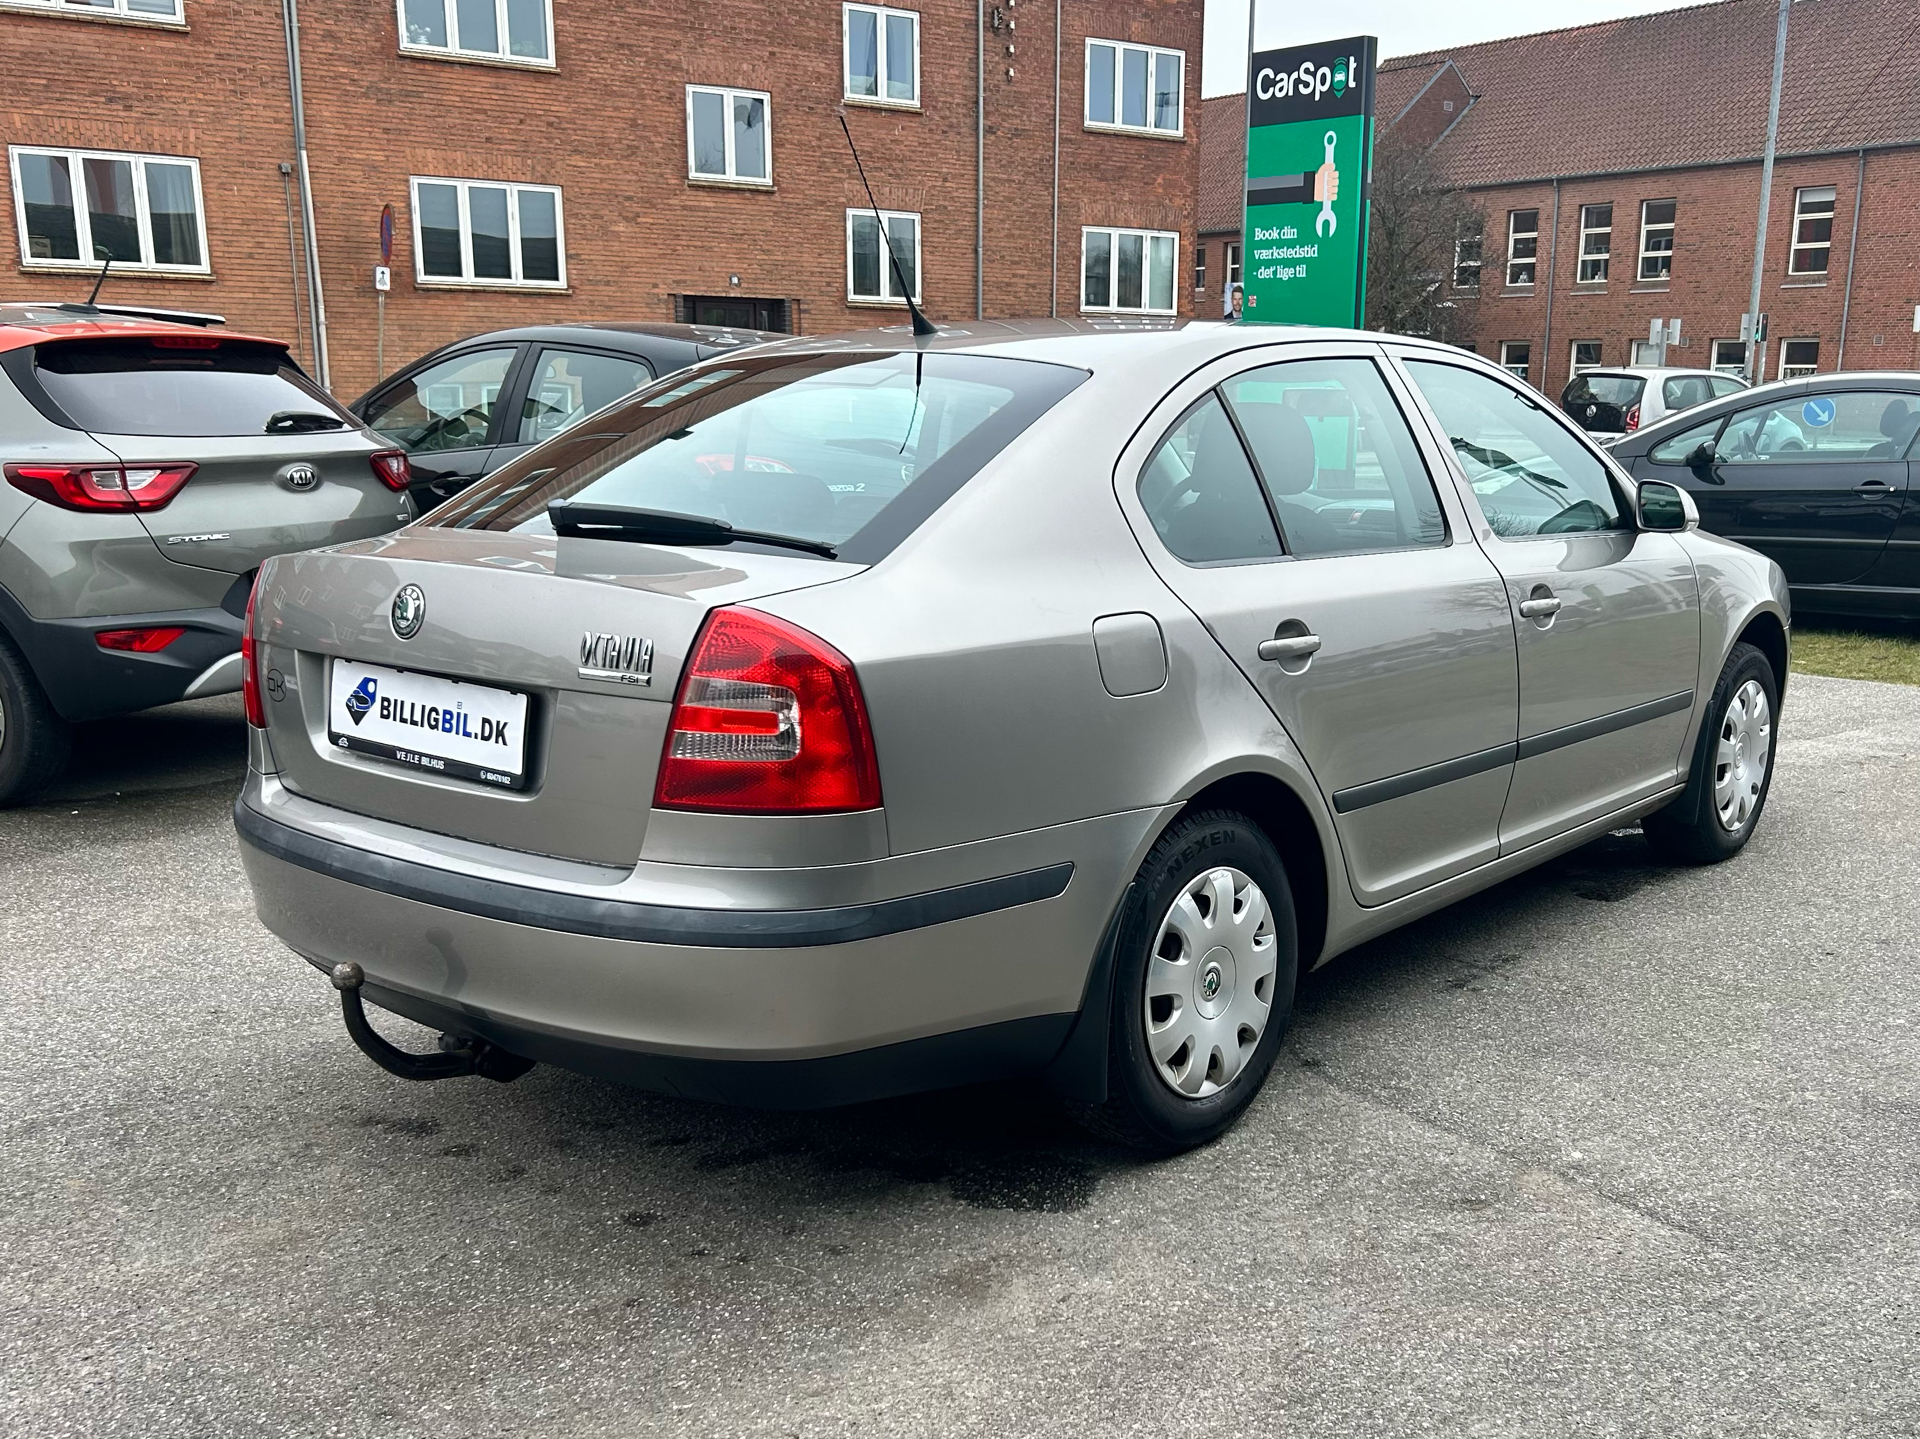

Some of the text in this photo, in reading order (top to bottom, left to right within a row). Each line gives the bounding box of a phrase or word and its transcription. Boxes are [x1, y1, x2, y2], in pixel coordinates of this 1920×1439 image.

[1256, 56, 1357, 101] CarSpot
[1254, 225, 1298, 241] Book din
[1254, 244, 1319, 260] værkstedstid
[1276, 264, 1295, 281] lige
[1295, 264, 1307, 278] til
[827, 482, 866, 492] azda 2
[167, 533, 230, 545] STONIC
[580, 631, 655, 674] OCTAVIA
[267, 677, 285, 695] DK
[620, 674, 639, 684] FSI
[379, 695, 509, 747] BILLIGBIL.DK
[396, 750, 445, 770] VEJLE BILHUS
[1166, 829, 1236, 880] NEXEN
